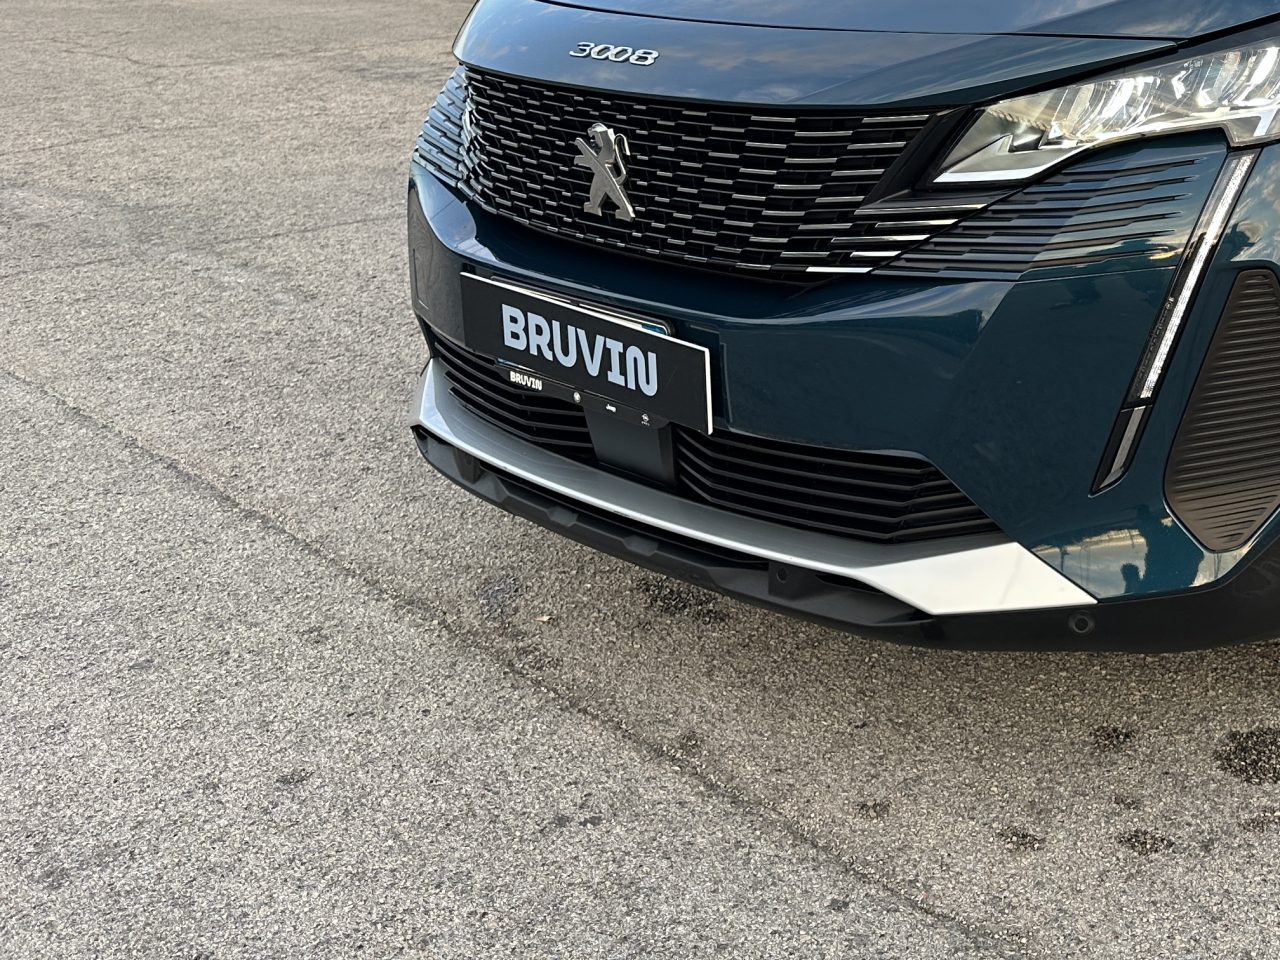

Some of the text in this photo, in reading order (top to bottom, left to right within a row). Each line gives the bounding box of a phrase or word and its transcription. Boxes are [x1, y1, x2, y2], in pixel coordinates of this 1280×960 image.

[569, 41, 659, 66] 3008
[502, 303, 658, 397] BRUVIN
[509, 371, 543, 391] BRUVIN
